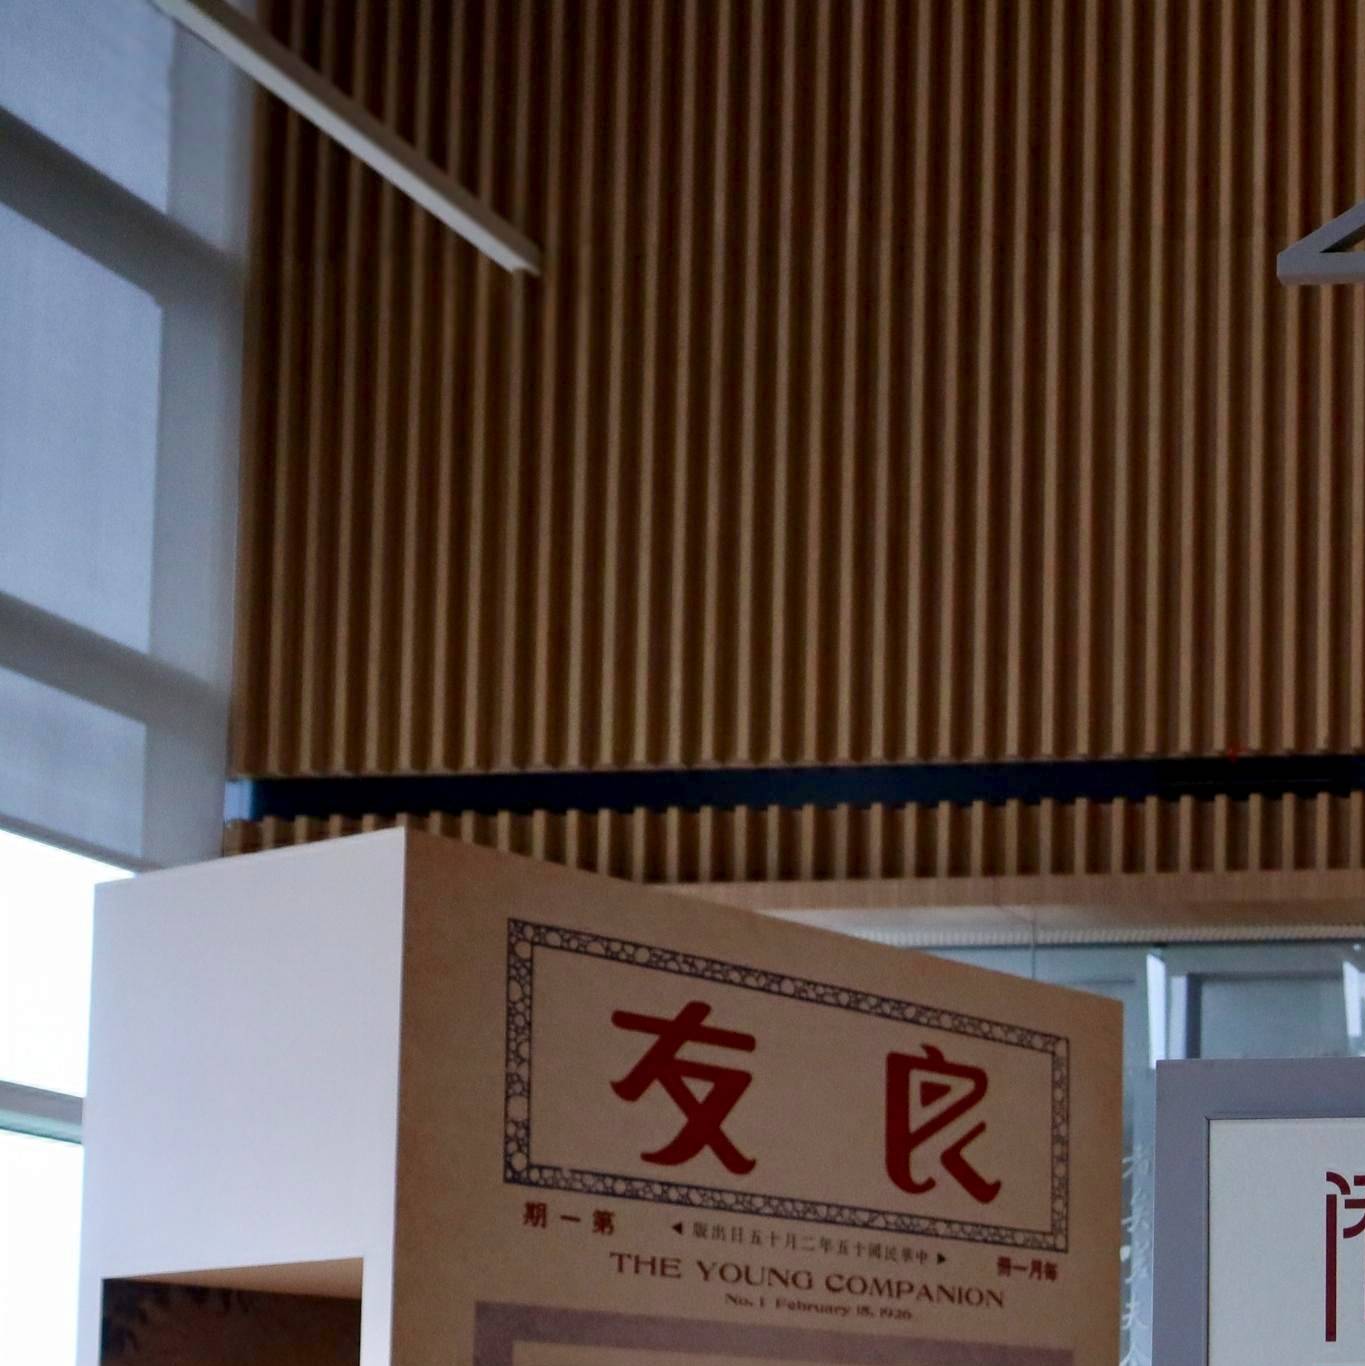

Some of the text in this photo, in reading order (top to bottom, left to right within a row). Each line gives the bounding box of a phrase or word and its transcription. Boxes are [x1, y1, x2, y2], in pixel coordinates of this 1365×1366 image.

[609, 1251, 1005, 1308] THE YOUNG COMPANION
